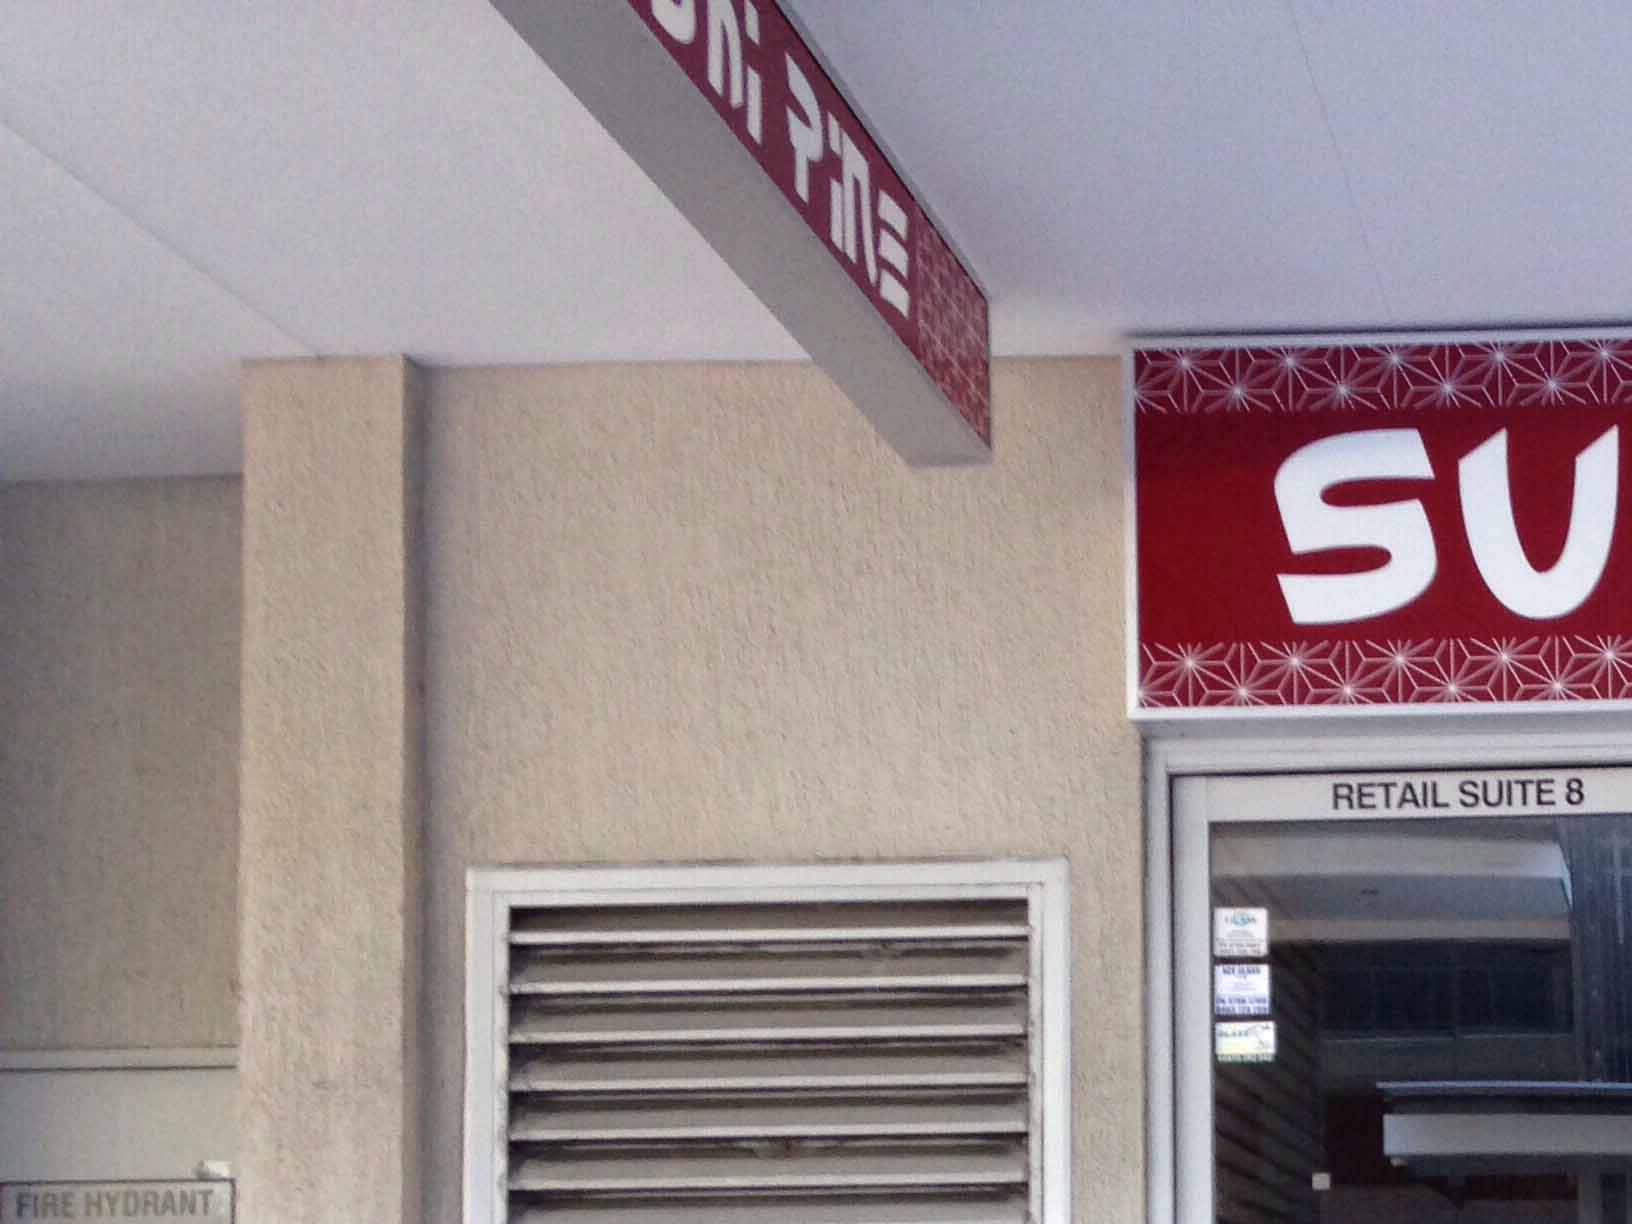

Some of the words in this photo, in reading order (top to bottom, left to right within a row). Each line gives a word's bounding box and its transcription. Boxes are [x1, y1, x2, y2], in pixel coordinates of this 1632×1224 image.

[1332, 780, 1449, 810] RETAIL
[1458, 779, 1556, 808] SUITE
[1565, 777, 1585, 805] 8
[15, 1190, 75, 1219] FIRE
[85, 1189, 213, 1218] HYDRANT
